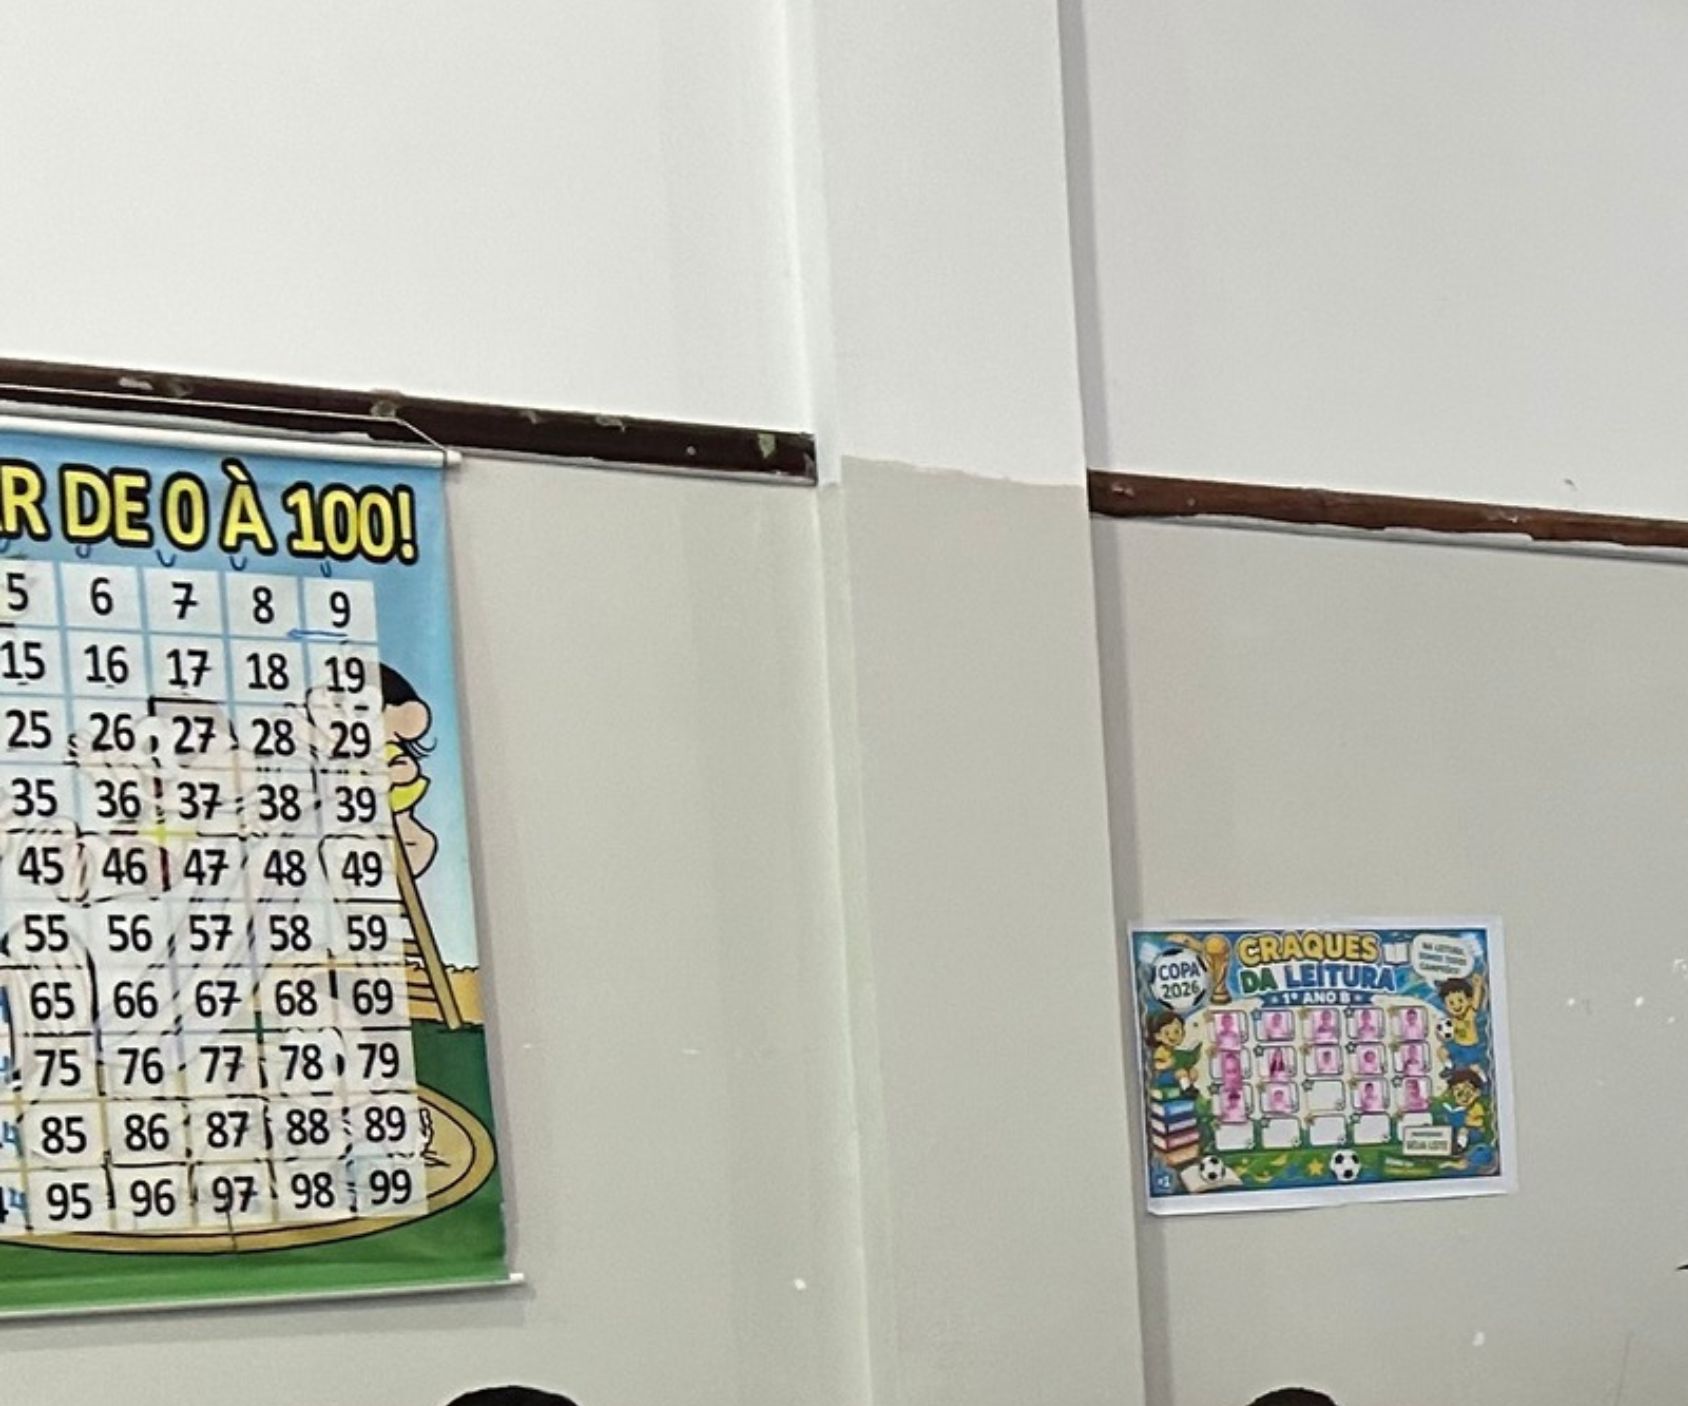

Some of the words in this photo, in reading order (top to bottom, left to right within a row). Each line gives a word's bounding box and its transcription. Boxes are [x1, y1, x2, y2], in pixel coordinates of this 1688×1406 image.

[0, 457, 52, 541] R
[58, 462, 155, 549] DE
[219, 455, 276, 558] À
[284, 483, 418, 564] 100!
[6, 572, 29, 611] 5
[91, 577, 114, 615] 6
[172, 581, 199, 619] 7
[252, 586, 274, 623] 8
[330, 591, 351, 628] 9
[19, 846, 64, 885] 45
[103, 847, 148, 885] 46
[183, 848, 228, 886] 47
[264, 848, 307, 887] 48
[342, 850, 382, 887] 49
[1237, 930, 1380, 968] CRAQUES
[1159, 961, 1201, 981] COPA
[1239, 967, 1278, 994] DA
[1284, 962, 1396, 991] LEITURA
[1160, 980, 1201, 999] 2026
[1303, 992, 1336, 1005] ANO
